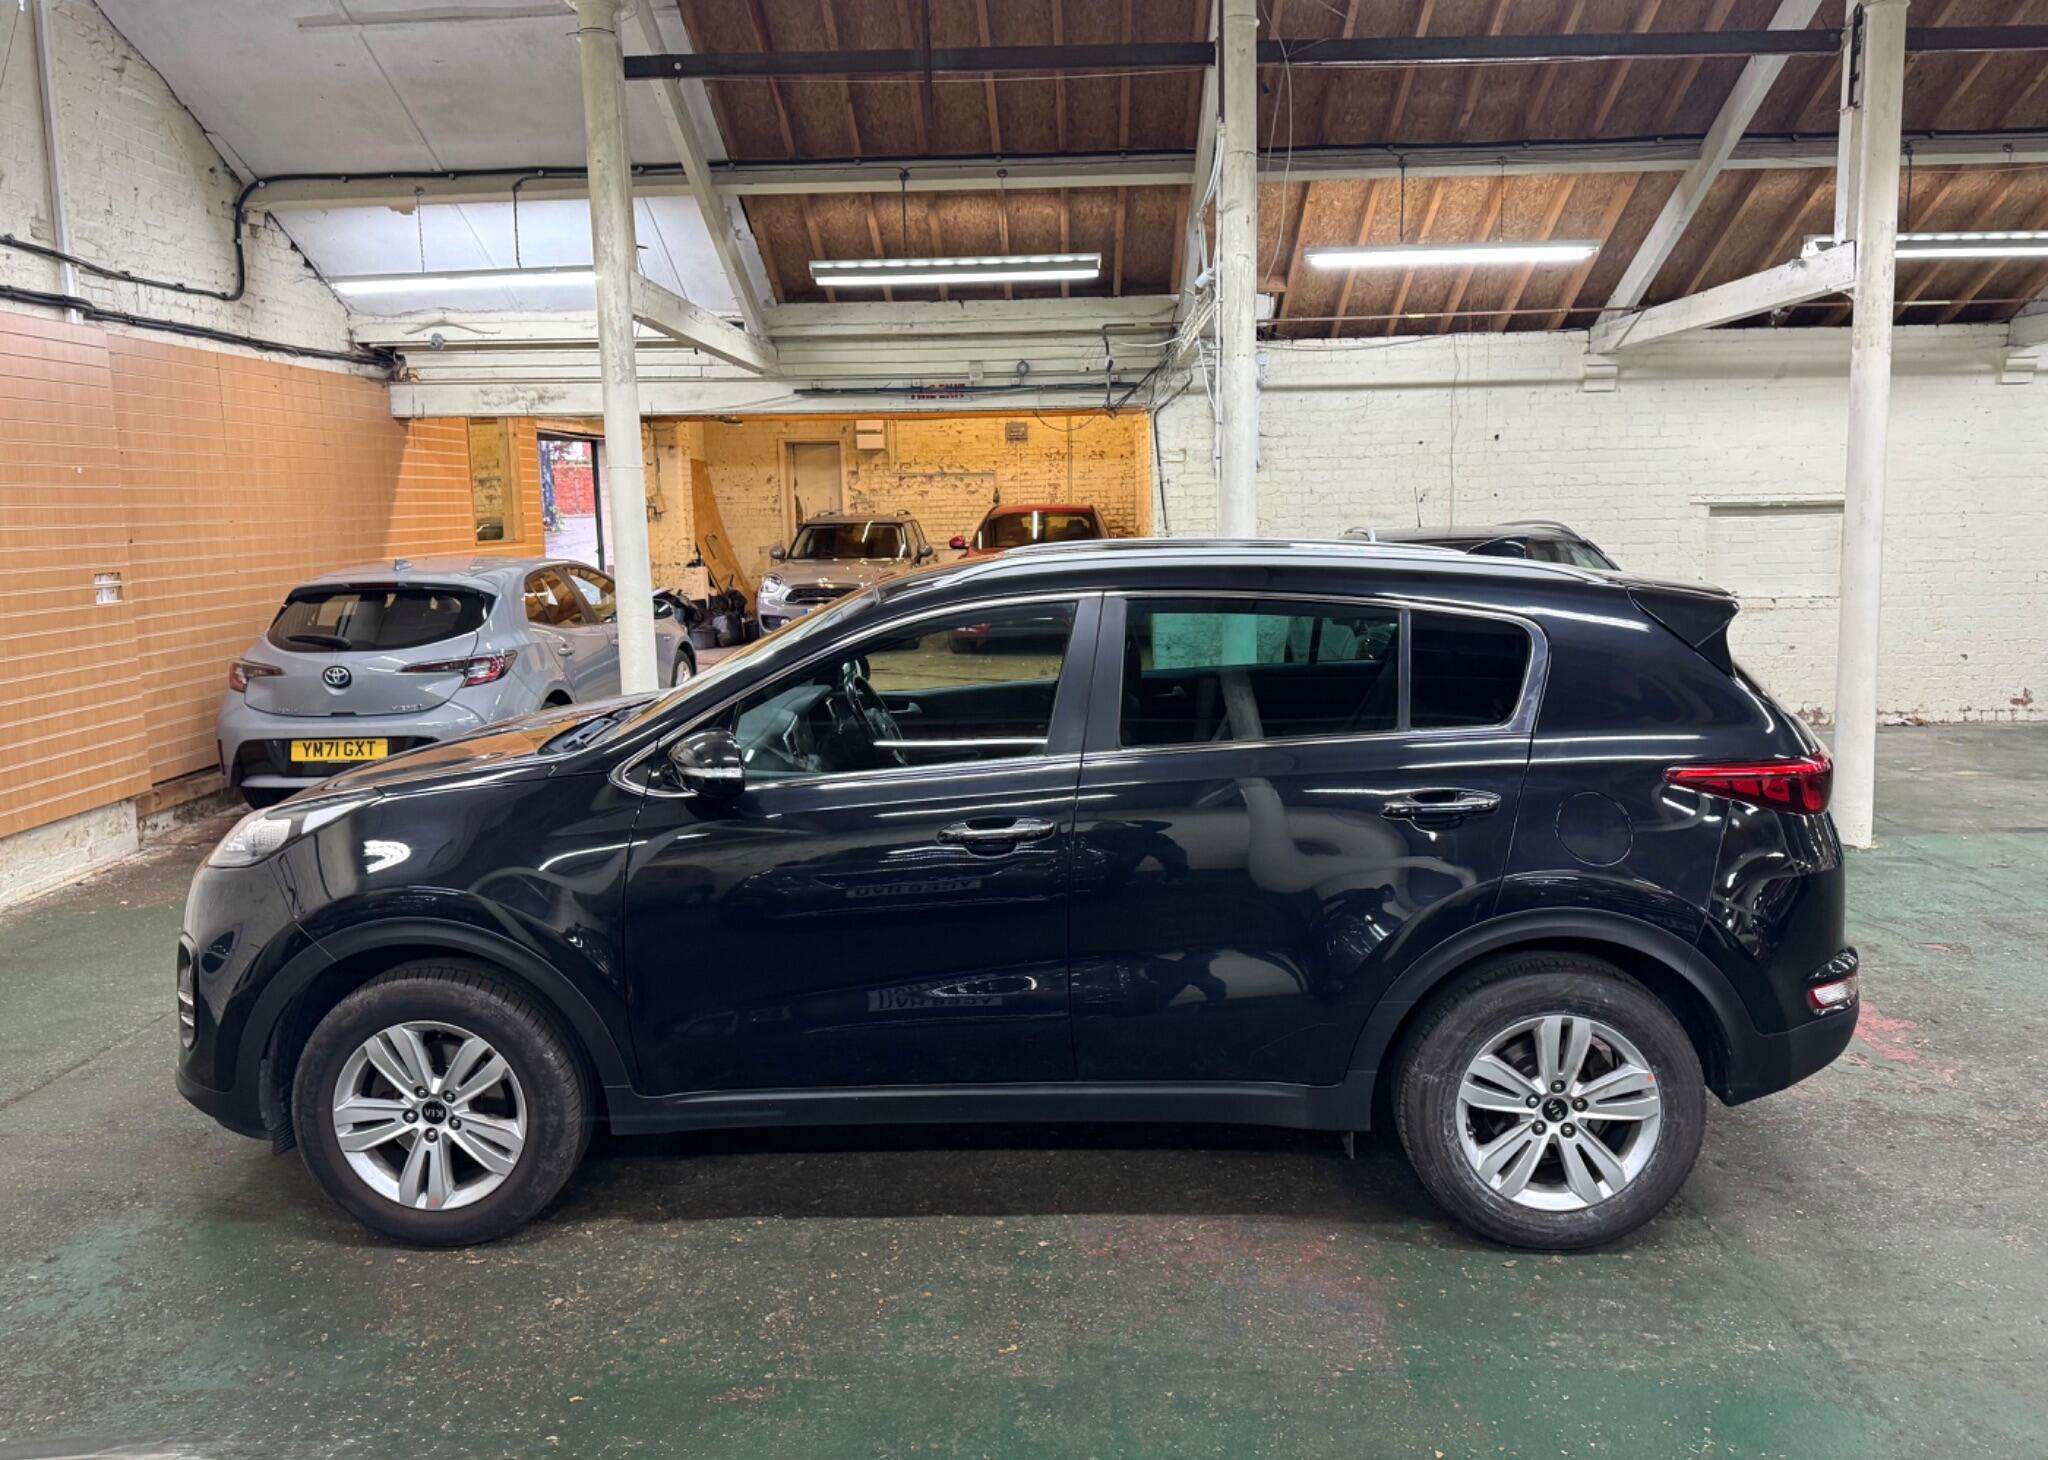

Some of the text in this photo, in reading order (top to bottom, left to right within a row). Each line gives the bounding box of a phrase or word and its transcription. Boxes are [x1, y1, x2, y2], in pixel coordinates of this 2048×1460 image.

[302, 741, 376, 757] YM71 GXT
[424, 1108, 444, 1118] KIA
